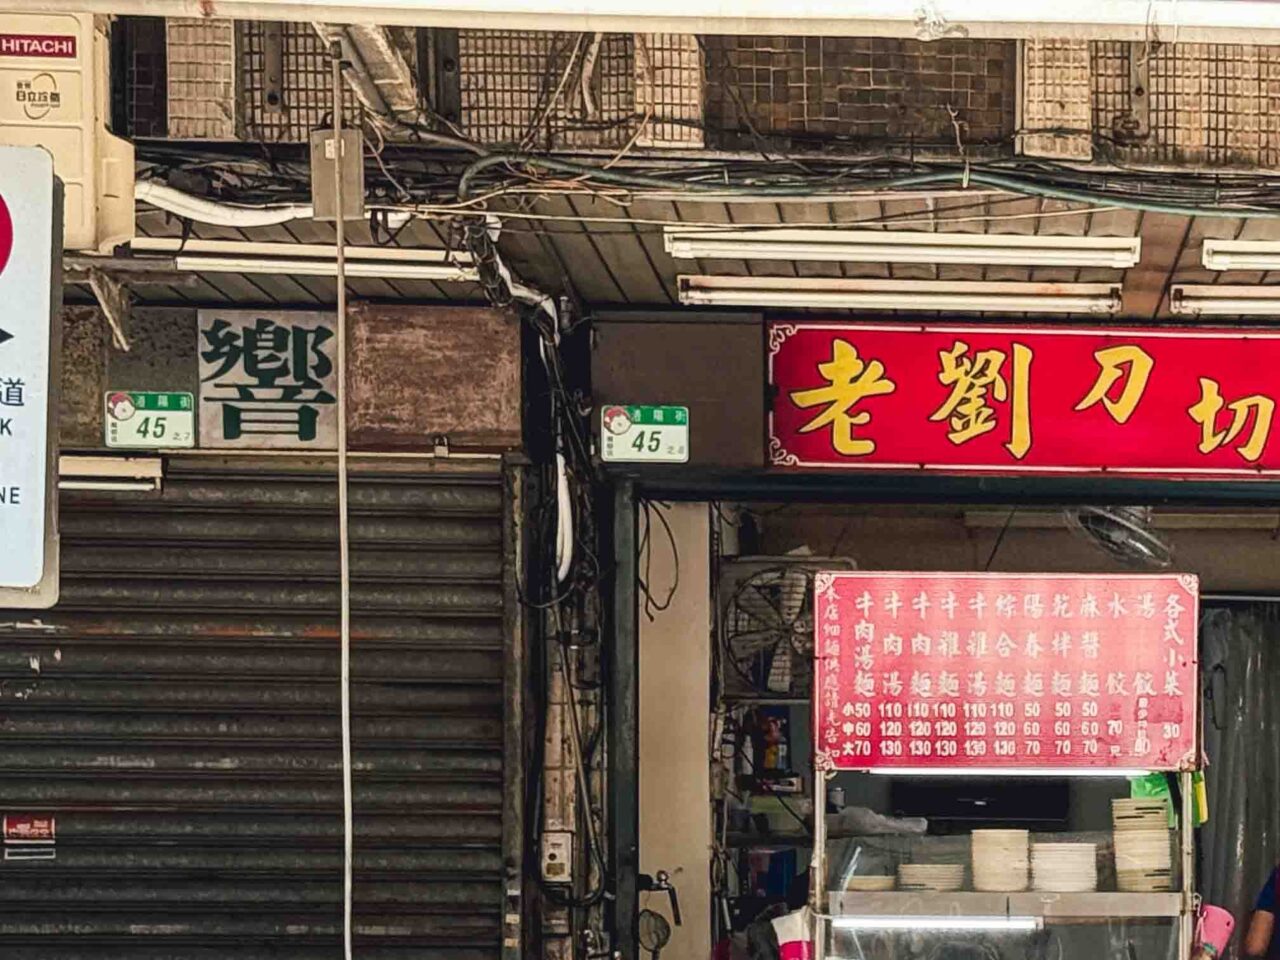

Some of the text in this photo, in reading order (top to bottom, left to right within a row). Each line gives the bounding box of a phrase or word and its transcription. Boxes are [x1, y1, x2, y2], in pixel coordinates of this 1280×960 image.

[1, 38, 73, 54] HITACHI
[201, 318, 336, 441] 響
[136, 416, 167, 439] 45
[631, 429, 662, 453] 45
[854, 591, 876, 697] 牛肉湯麵
[882, 590, 903, 697] 牛肉湯
[911, 591, 932, 698] 牛肉麵
[1022, 593, 1045, 698] 陽春麵
[1161, 594, 1186, 697] 各式小菜
[878, 702, 901, 718] 110
[907, 702, 929, 718] 110
[933, 702, 956, 717] 110
[963, 702, 987, 718] 110
[990, 702, 1014, 717] 110
[1024, 702, 1041, 717] 50
[1055, 702, 1072, 717] 50
[1082, 702, 1098, 717] 50
[1023, 721, 1041, 736] 60
[1054, 721, 1071, 736] 60
[1081, 721, 1099, 736] 60
[1163, 723, 1180, 739] 30
[1025, 740, 1041, 755] 70
[1055, 740, 1072, 755] 70
[1082, 740, 1098, 755] 70
